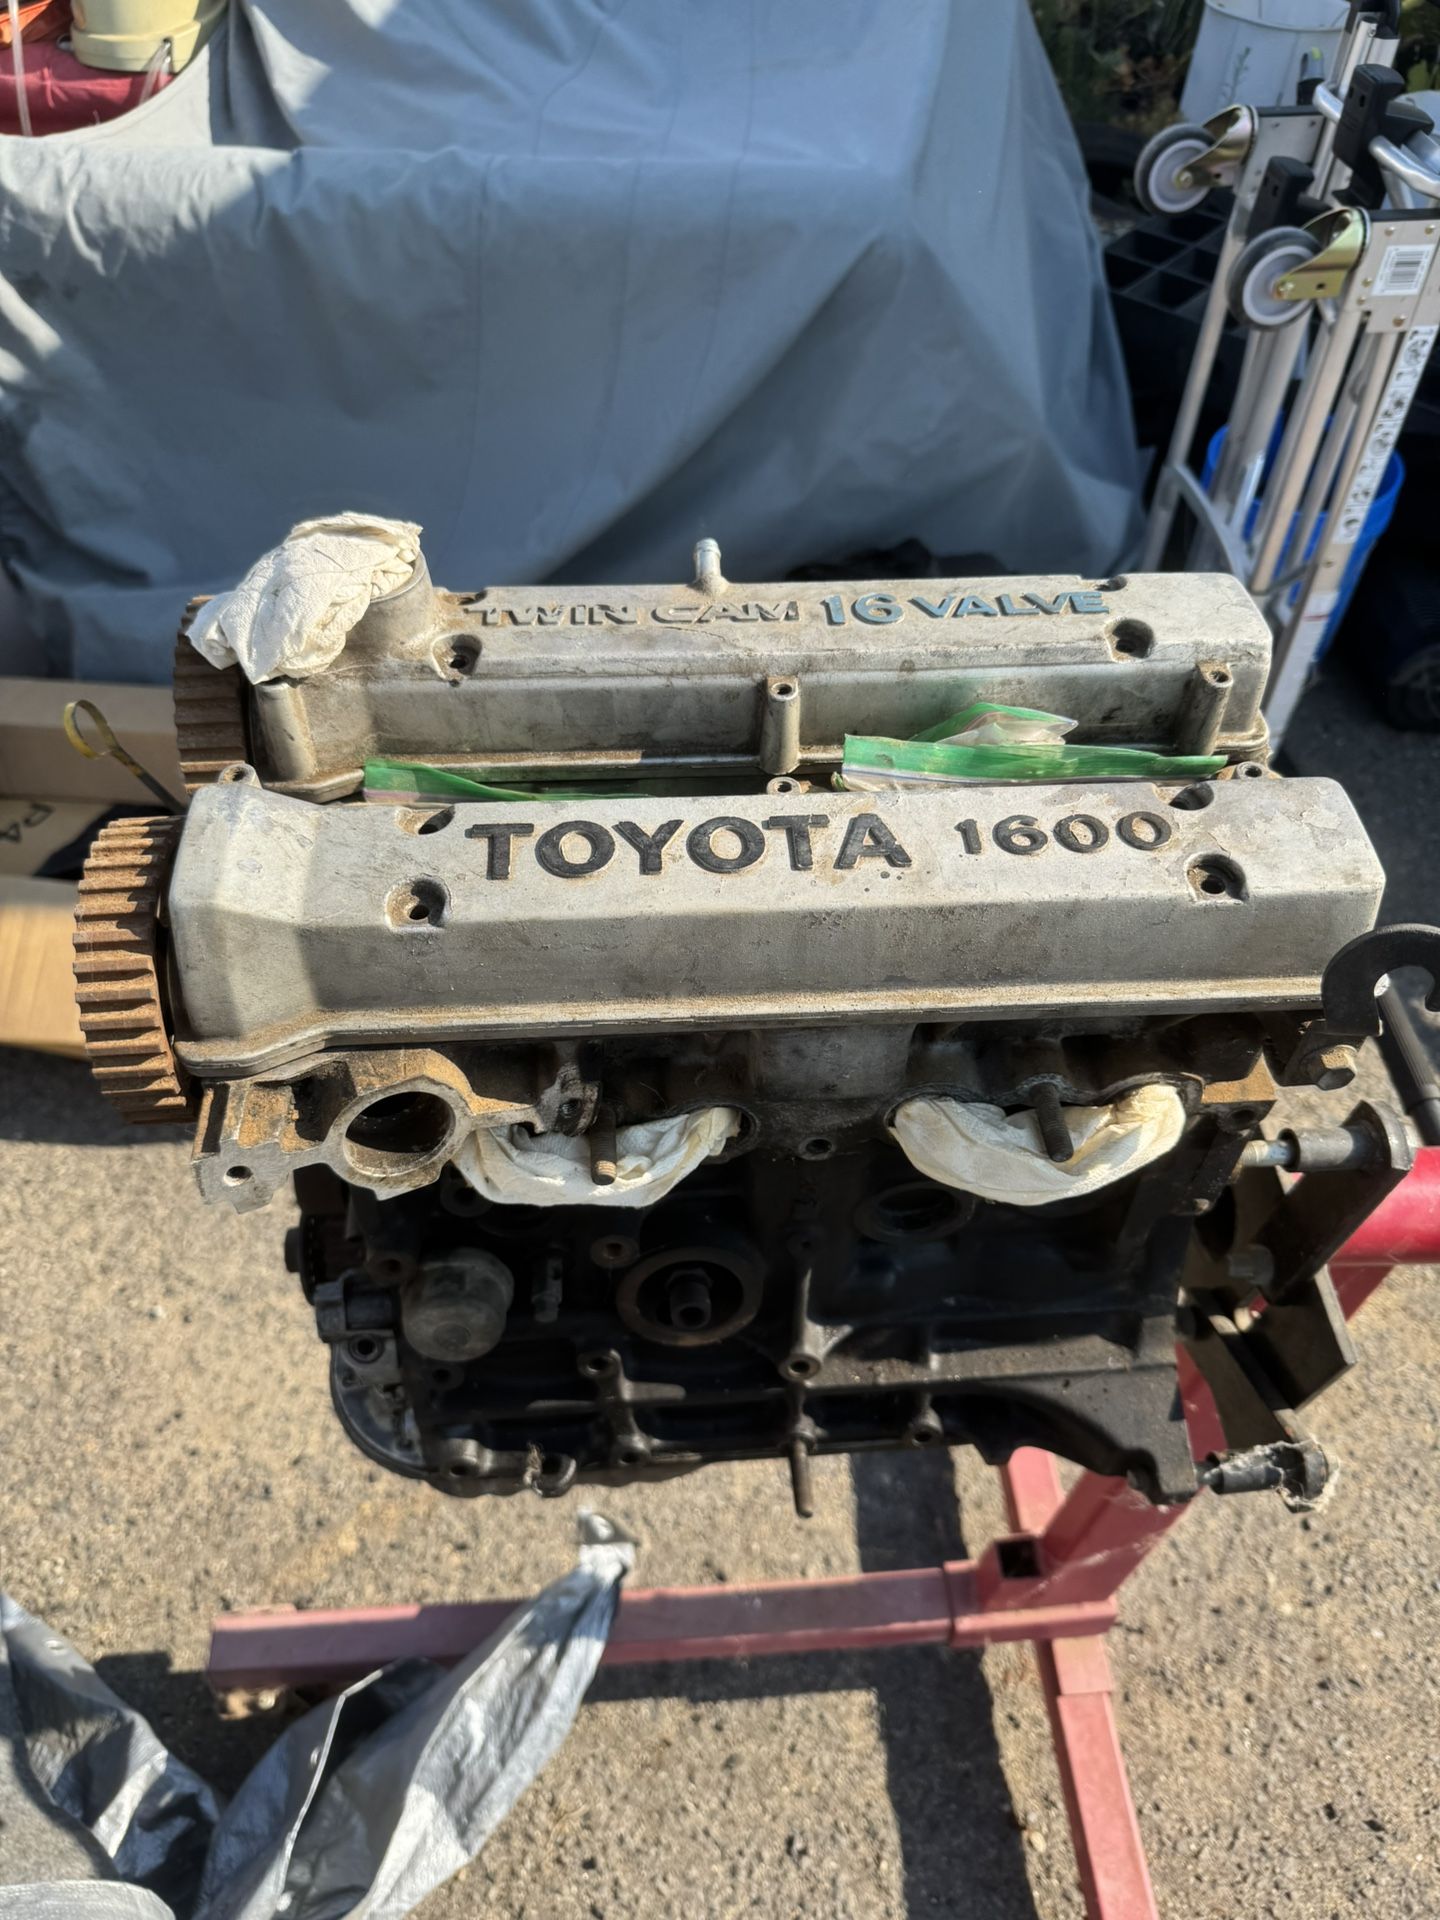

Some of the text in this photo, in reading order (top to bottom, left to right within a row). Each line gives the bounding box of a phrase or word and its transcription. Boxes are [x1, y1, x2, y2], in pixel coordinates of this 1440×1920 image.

[464, 591, 1110, 626] TWIN CAM 16 VALVE
[465, 811, 1172, 881] TOYOTA 1600
